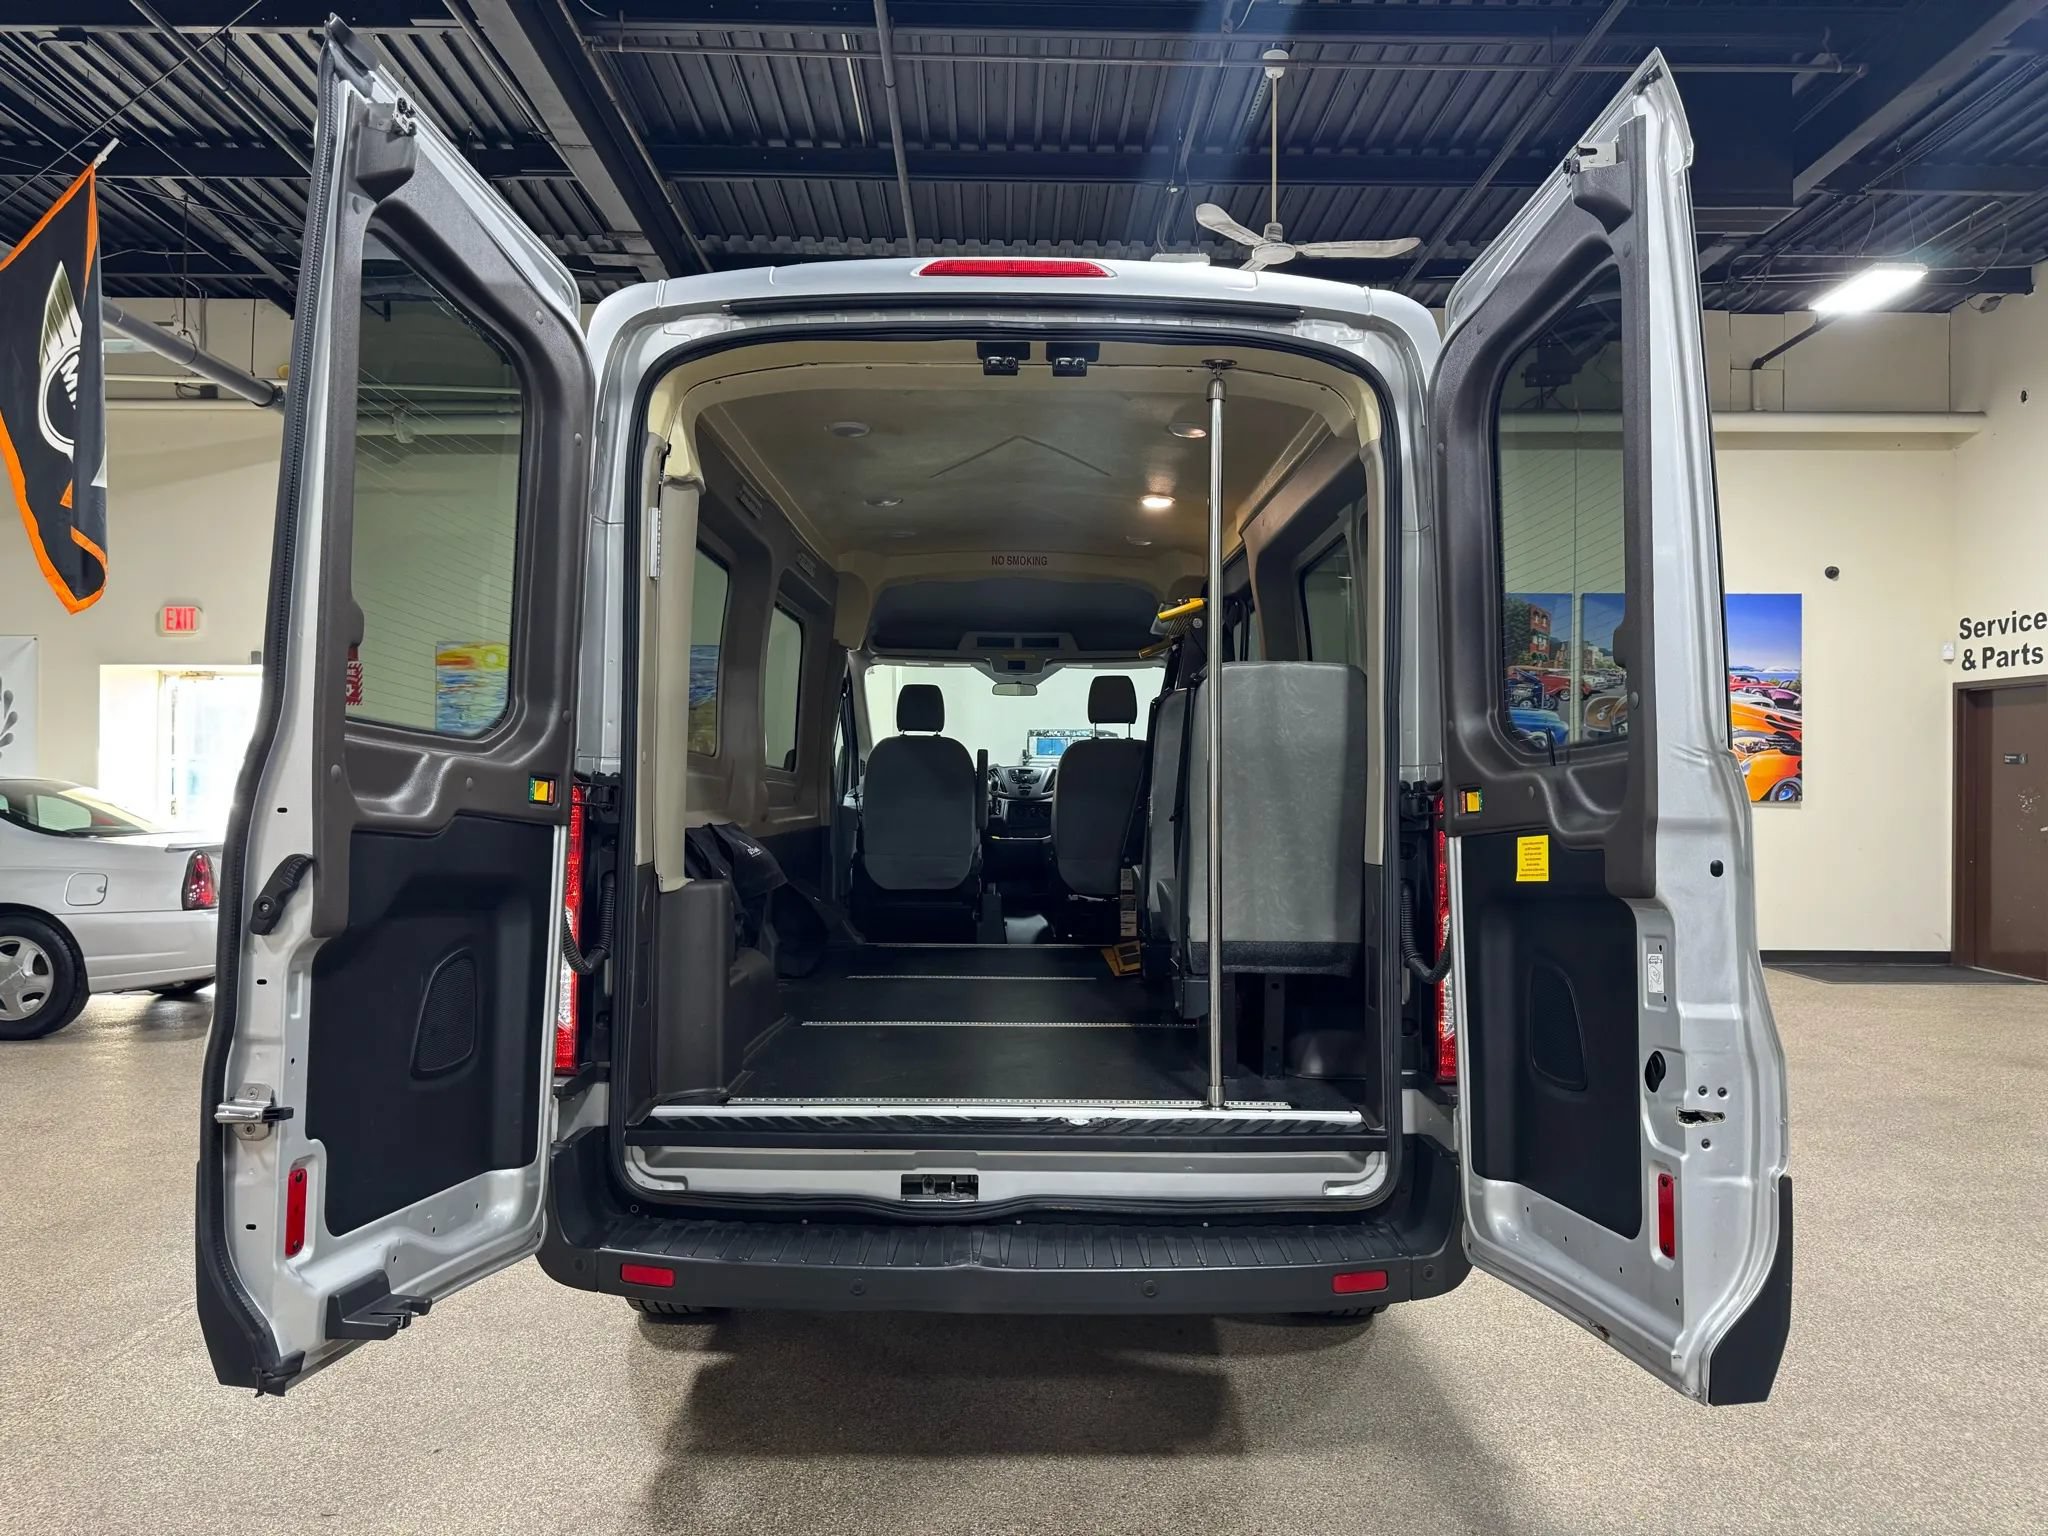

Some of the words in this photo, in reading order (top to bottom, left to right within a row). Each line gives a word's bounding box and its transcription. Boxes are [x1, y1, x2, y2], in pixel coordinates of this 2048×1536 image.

[991, 555, 1005, 566] NO
[1006, 555, 1048, 566] SMOKING
[166, 607, 195, 630] EXIT
[1959, 610, 2047, 640] Service
[1961, 648, 1977, 671] &
[1982, 643, 2044, 669] Parts
